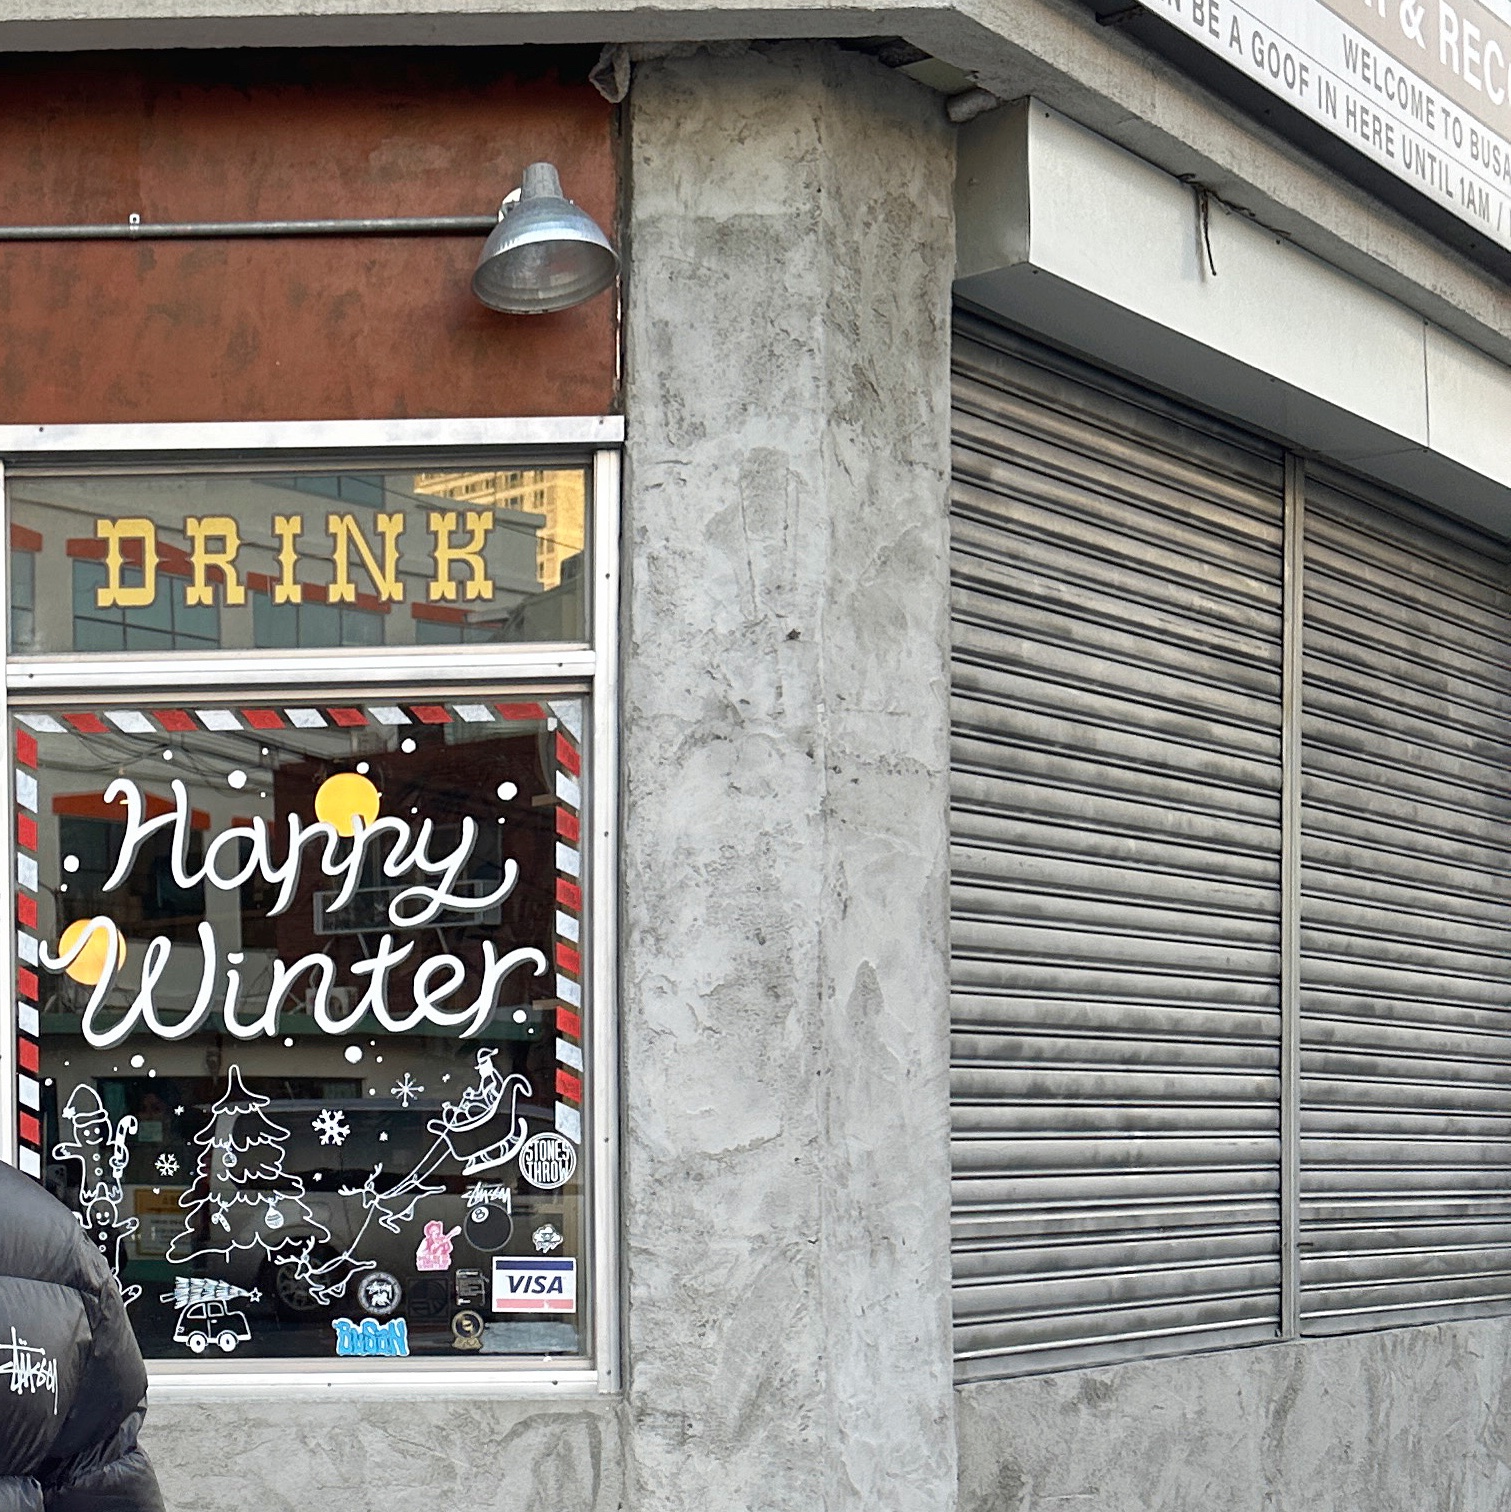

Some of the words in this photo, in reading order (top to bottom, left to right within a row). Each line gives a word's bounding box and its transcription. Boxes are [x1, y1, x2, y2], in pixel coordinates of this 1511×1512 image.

[1343, 33, 1435, 131] WELCOME
[1441, 106, 1463, 149] TO
[1439, 0, 1511, 106] REC
[1192, 0, 1220, 39] BE
[1229, 15, 1243, 55] A
[1251, 30, 1309, 97] GOOF
[1318, 75, 1337, 119] IN
[1346, 95, 1395, 159] HERE
[1402, 134, 1454, 199] UNTIL
[1460, 177, 1490, 223] 1AM
[95, 510, 496, 609] DRINK
[102, 777, 520, 926] Happy
[40, 914, 548, 1049] Winter
[525, 1139, 572, 1162] STONES
[526, 1160, 569, 1183] THROW
[474, 1208, 486, 1220] 8
[506, 1275, 565, 1295] VISA
